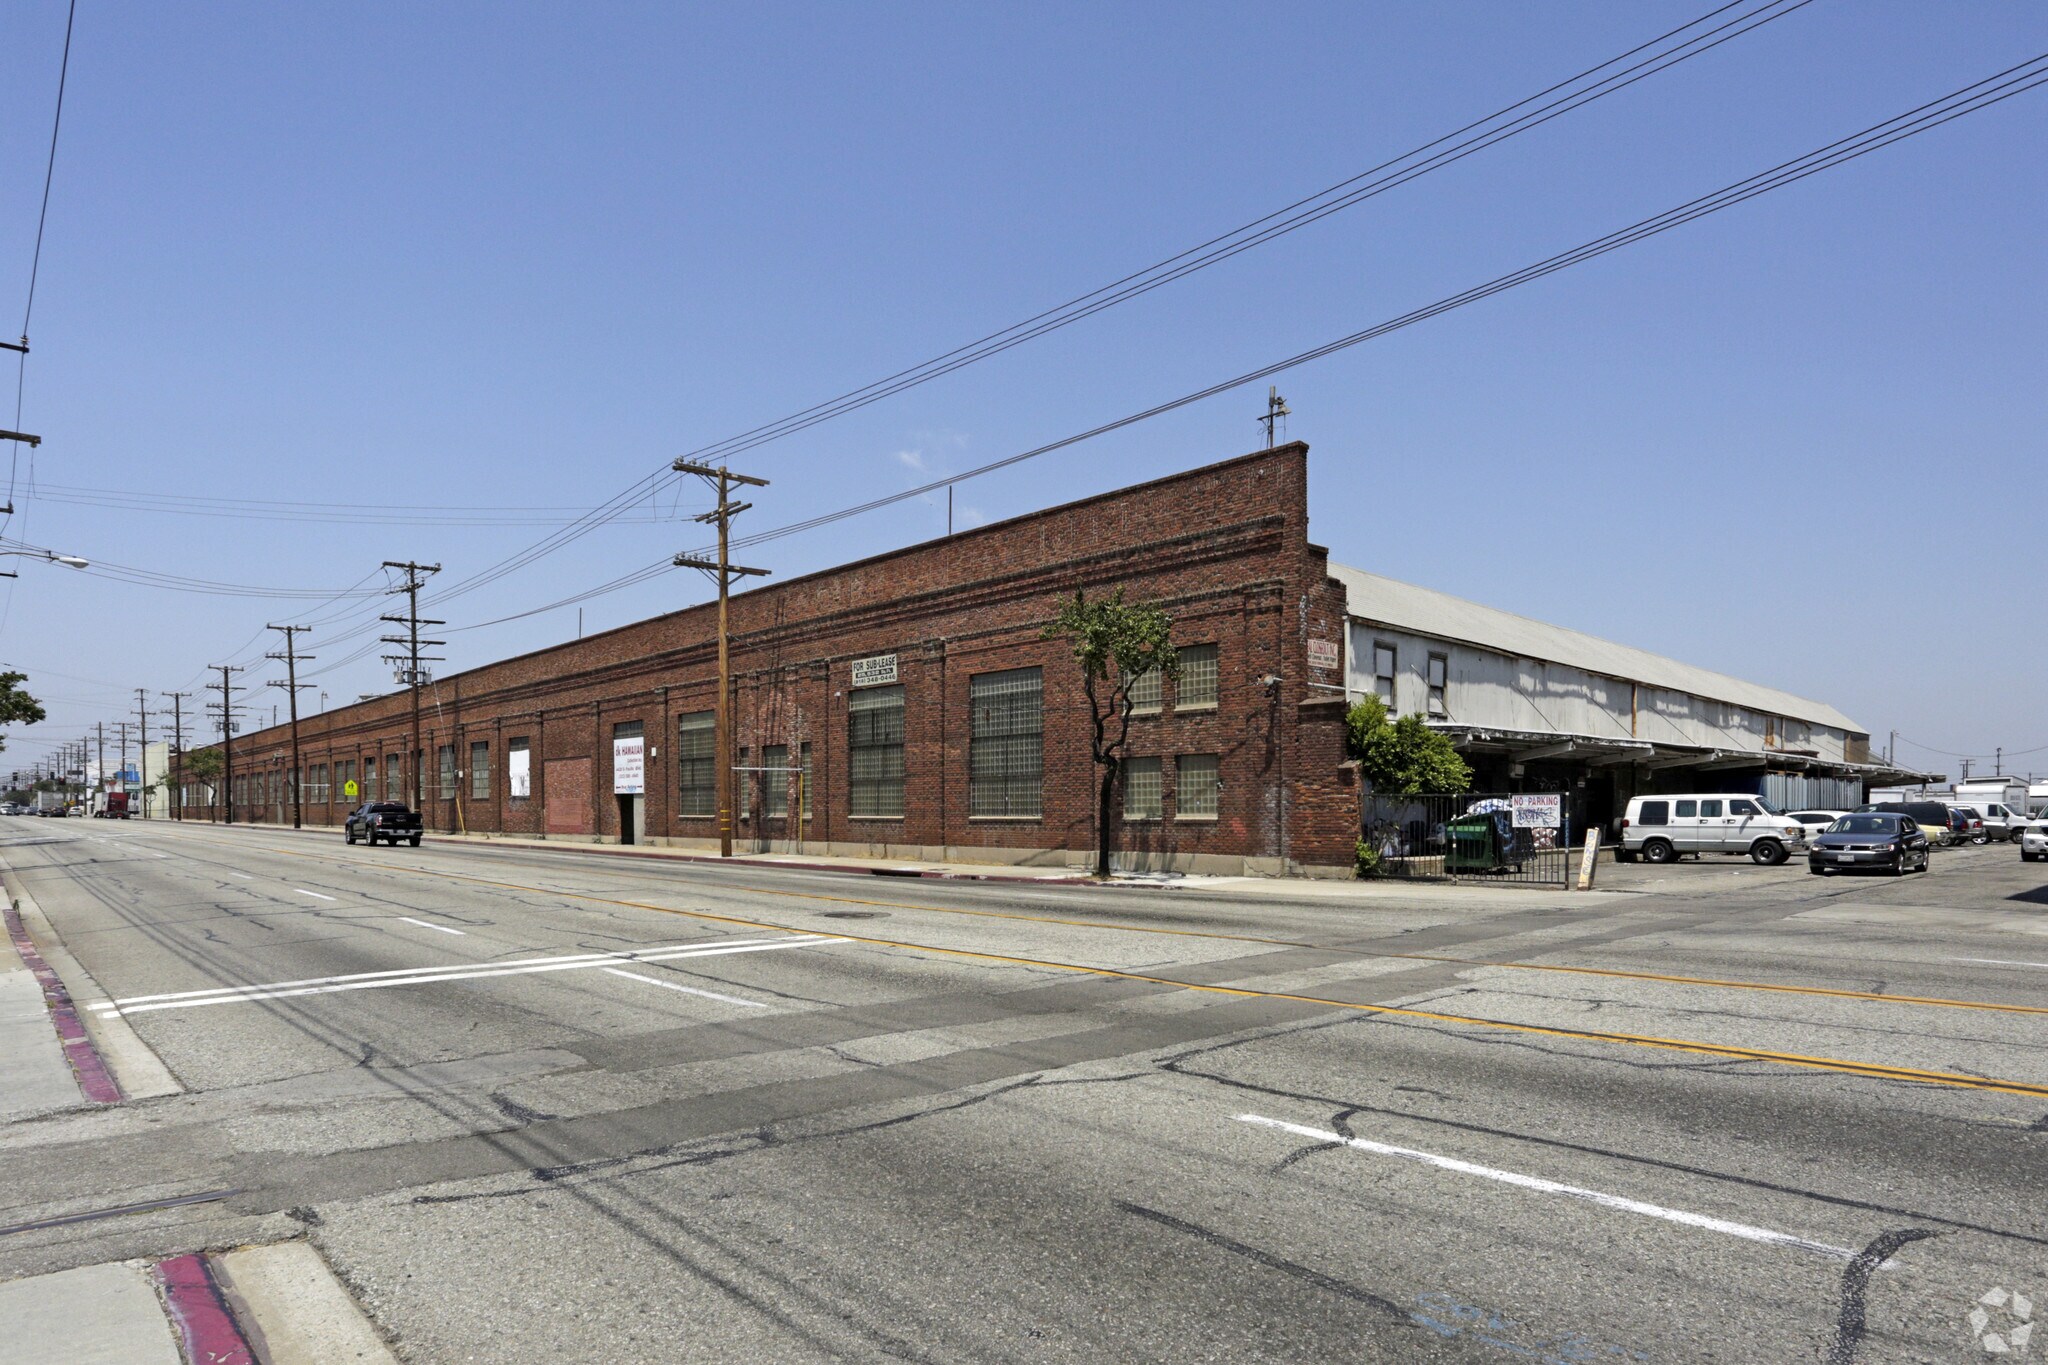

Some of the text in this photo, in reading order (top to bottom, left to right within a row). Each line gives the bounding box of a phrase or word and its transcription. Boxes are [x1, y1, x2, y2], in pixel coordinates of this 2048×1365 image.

[853, 656, 896, 672] FOR SUB-LEASE
[867, 674, 896, 683] 348-0446
[1514, 796, 1558, 806] NO PARKING
